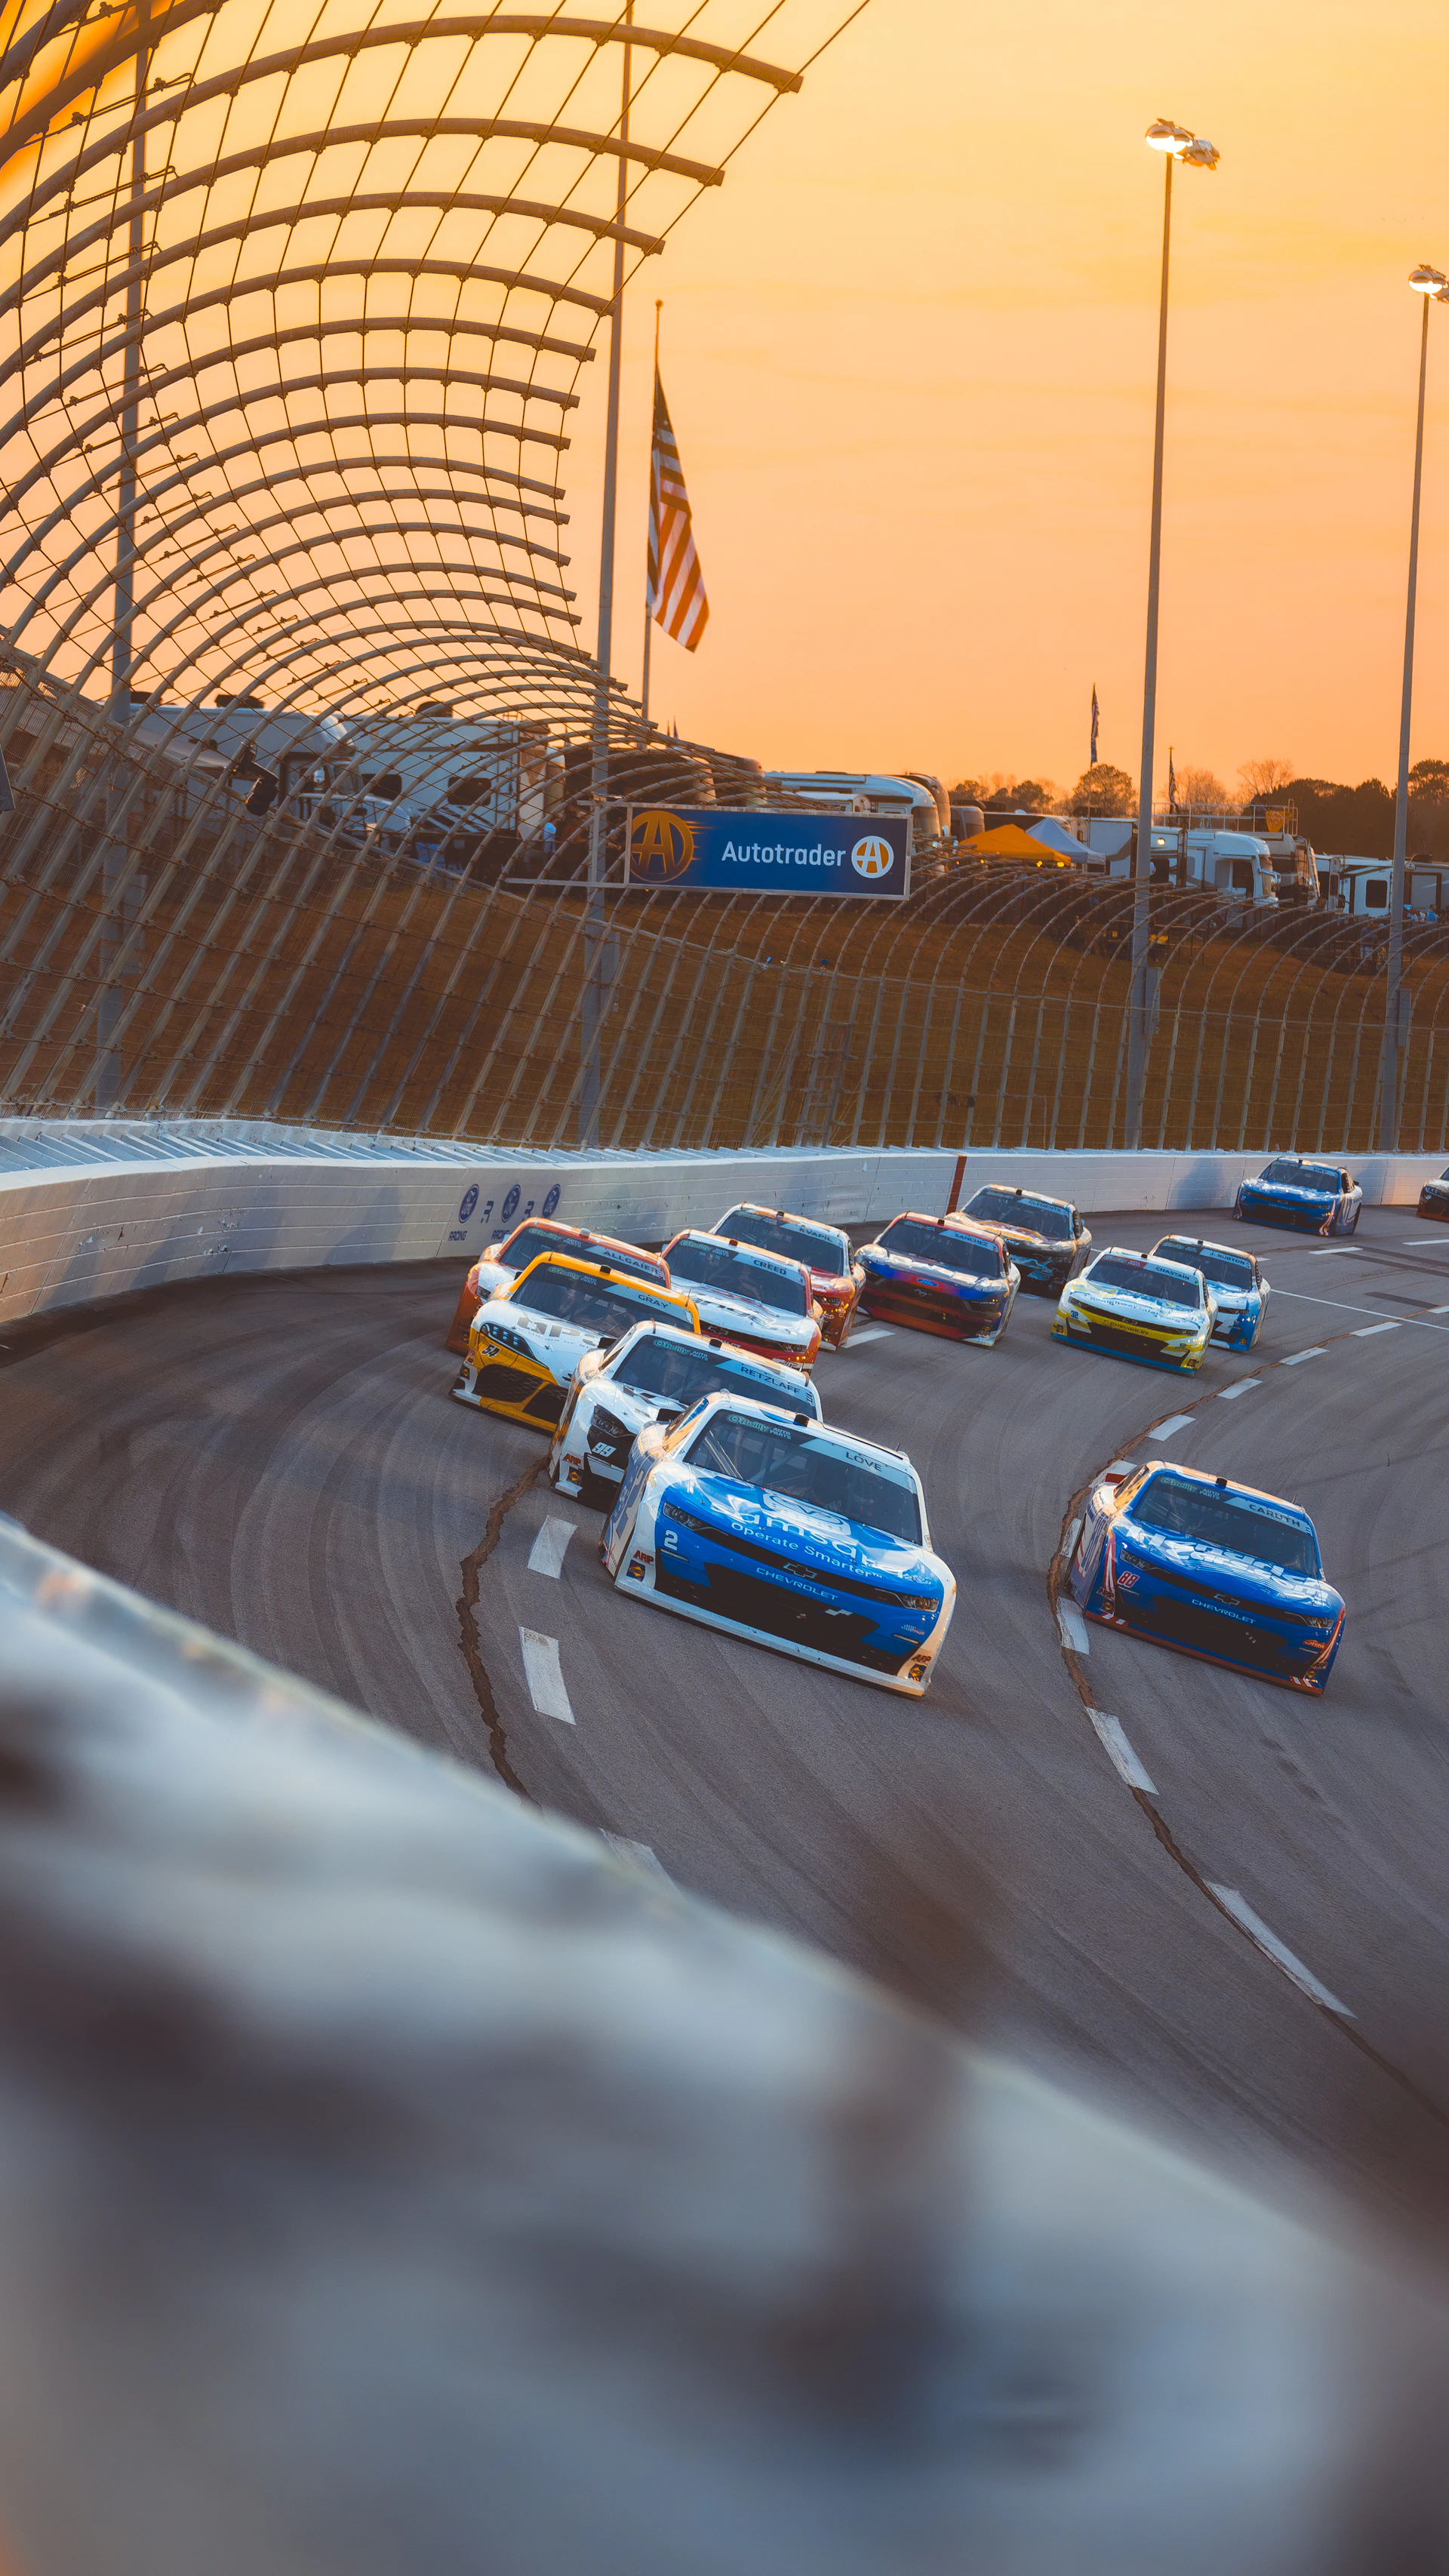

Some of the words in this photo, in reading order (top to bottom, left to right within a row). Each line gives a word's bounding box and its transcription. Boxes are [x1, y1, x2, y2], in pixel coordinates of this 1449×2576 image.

[721, 841, 846, 867] Autotrader
[448, 1230, 467, 1241] RACING
[799, 1227, 832, 1242] KVAPIL
[954, 1233, 989, 1247] SANCHEZ
[603, 1250, 659, 1273] ALLGAIER
[1217, 1253, 1245, 1265] BURTON
[754, 1259, 786, 1276] CREED
[1156, 1266, 1189, 1280] CHASTAIN
[638, 1294, 669, 1309] GRAY
[1070, 1310, 1079, 1319] 32
[481, 1343, 502, 1358] 54
[740, 1365, 801, 1394] RETZLAFF
[770, 1430, 792, 1440] PARTS
[773, 1426, 791, 1436] AUTO
[592, 1442, 617, 1457] 99
[562, 1453, 582, 1466] ARP
[845, 1451, 882, 1472] LOVE
[1199, 1490, 1220, 1500] PARTS
[1249, 1503, 1300, 1528] CARUTH
[664, 1529, 678, 1551] 2
[731, 1522, 799, 1550] Operate
[632, 1550, 655, 1565] ARP
[756, 1567, 838, 1601] CHEVROLET
[1117, 1571, 1140, 1588] 88
[1192, 1599, 1256, 1624] CHEVROLET
